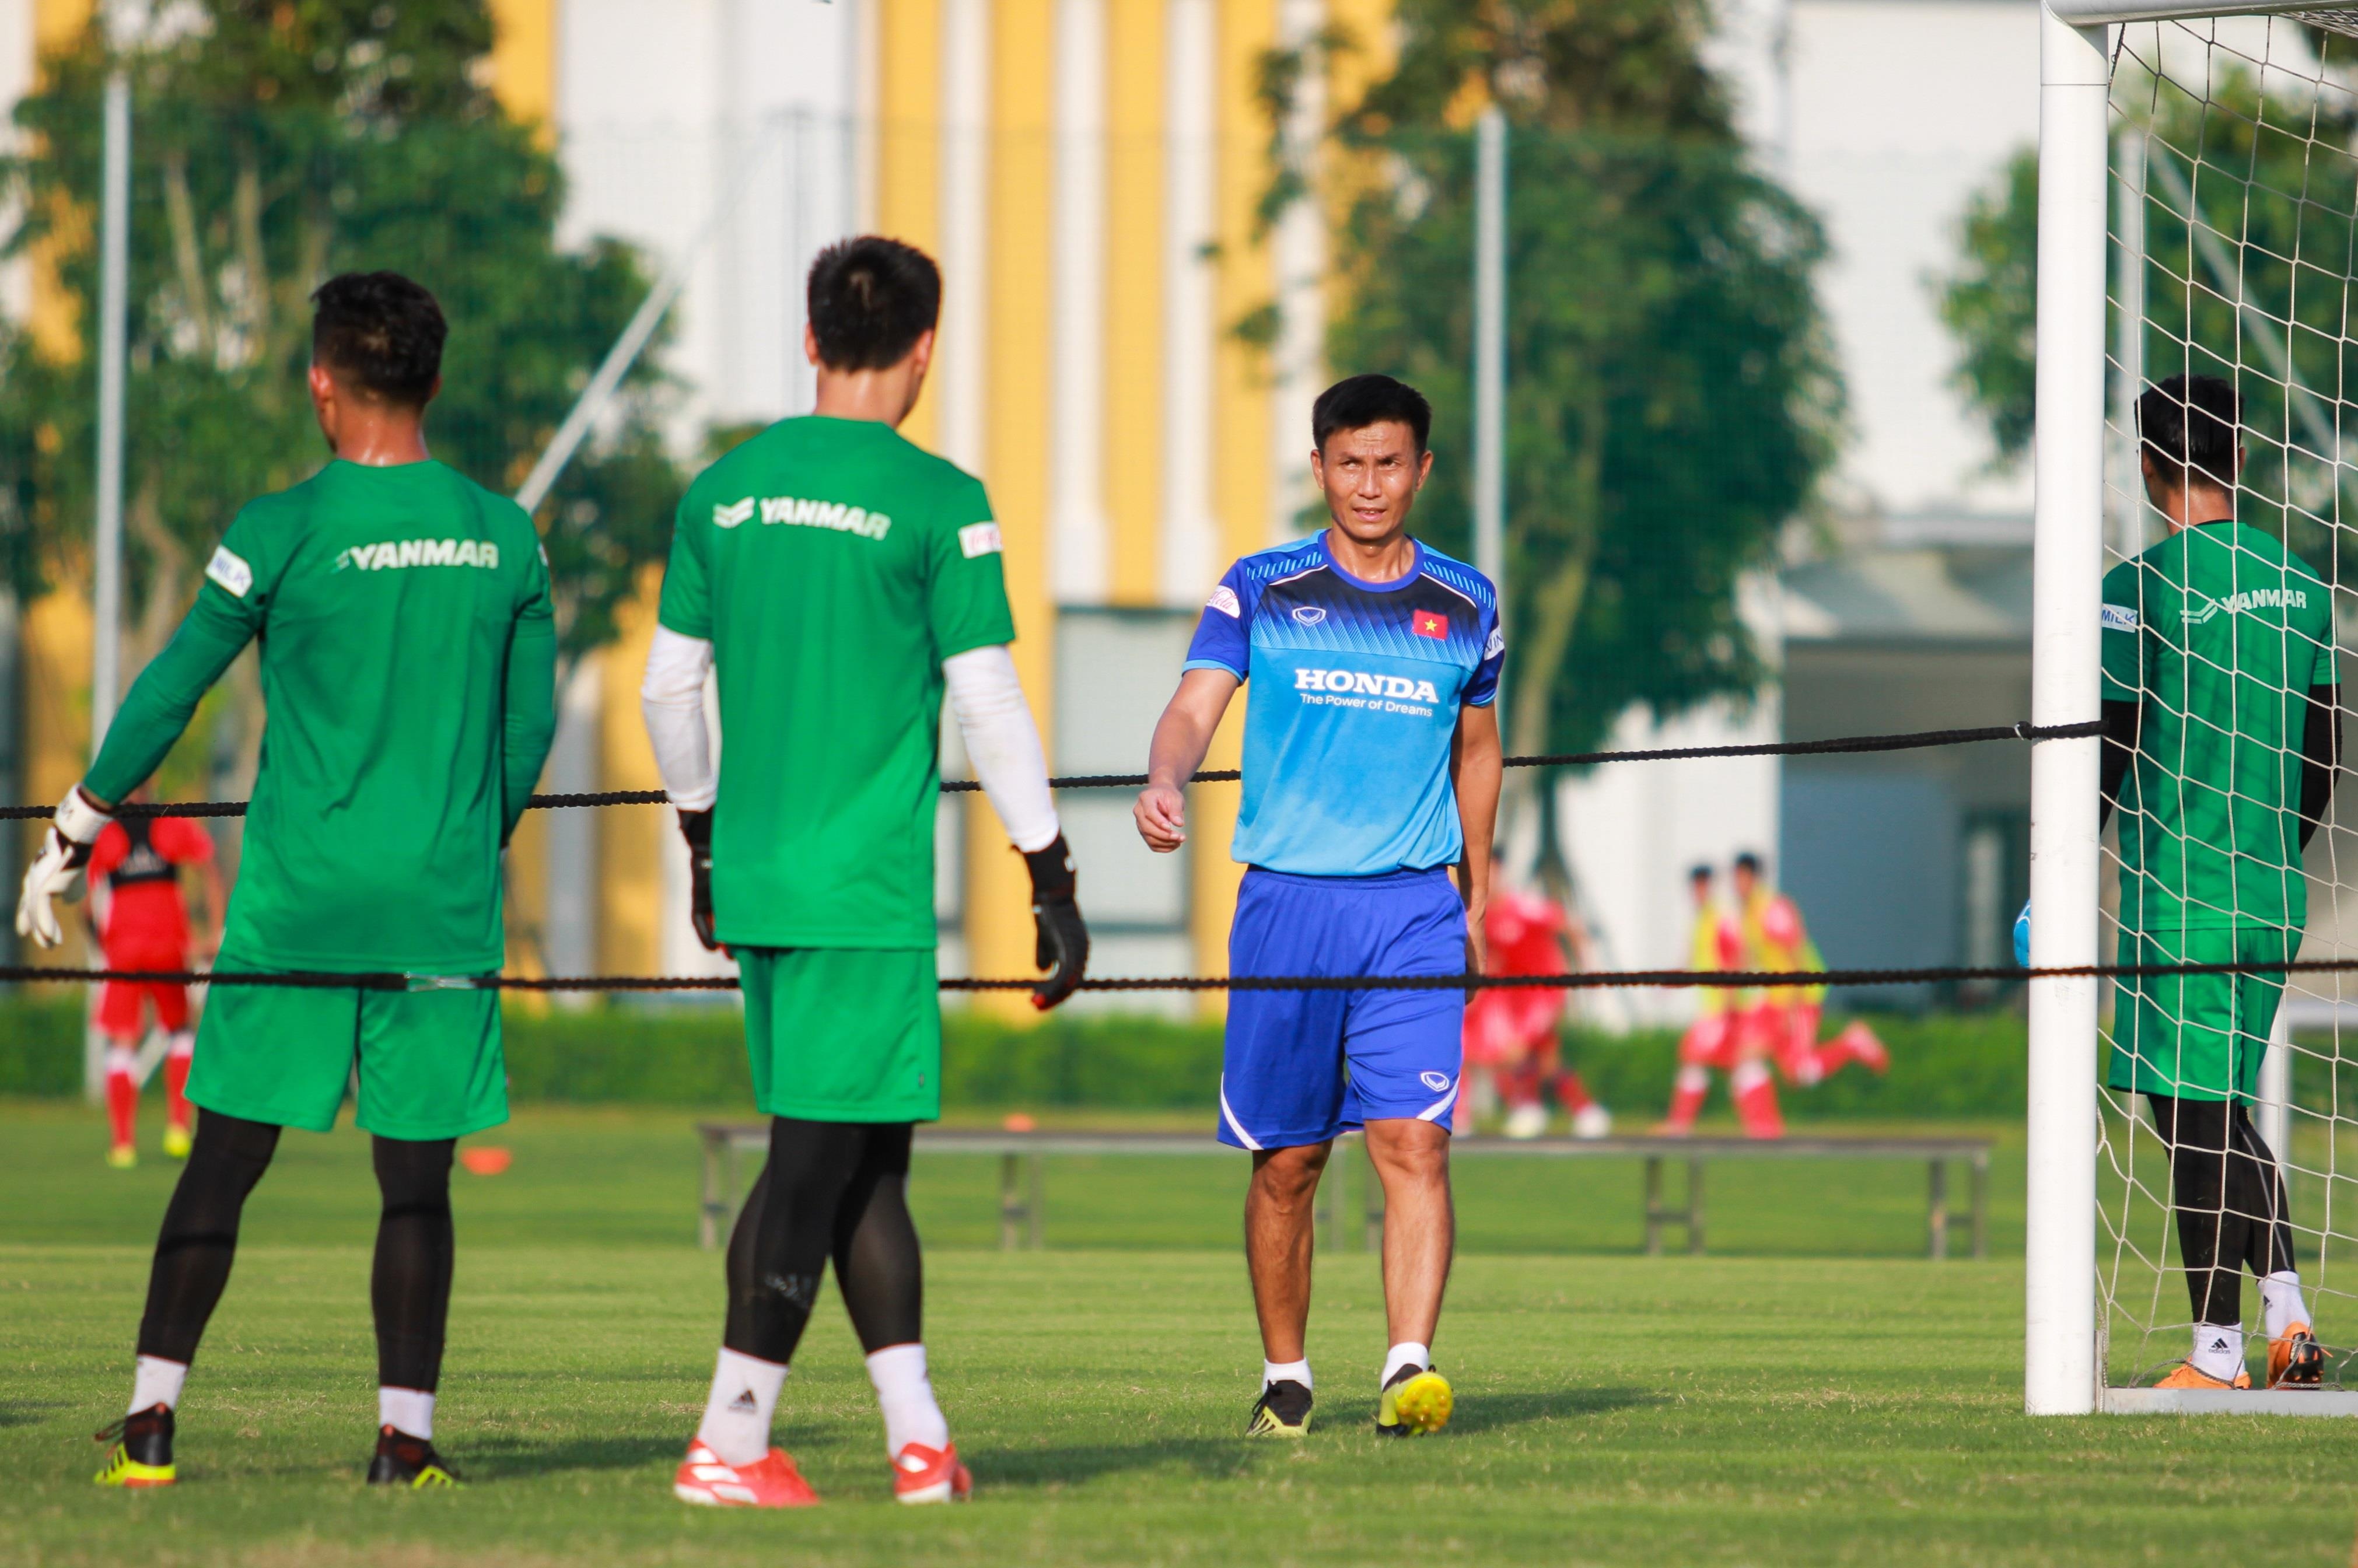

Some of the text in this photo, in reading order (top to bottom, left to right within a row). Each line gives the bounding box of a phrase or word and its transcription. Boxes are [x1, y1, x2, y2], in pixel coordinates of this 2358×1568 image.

[759, 496, 891, 541] YANMAR
[350, 538, 499, 571] YANMAR
[2220, 589, 2307, 614] YANMAR
[1295, 668, 1439, 703] HONDA
[1300, 693, 1433, 717] The Power of Dreams
